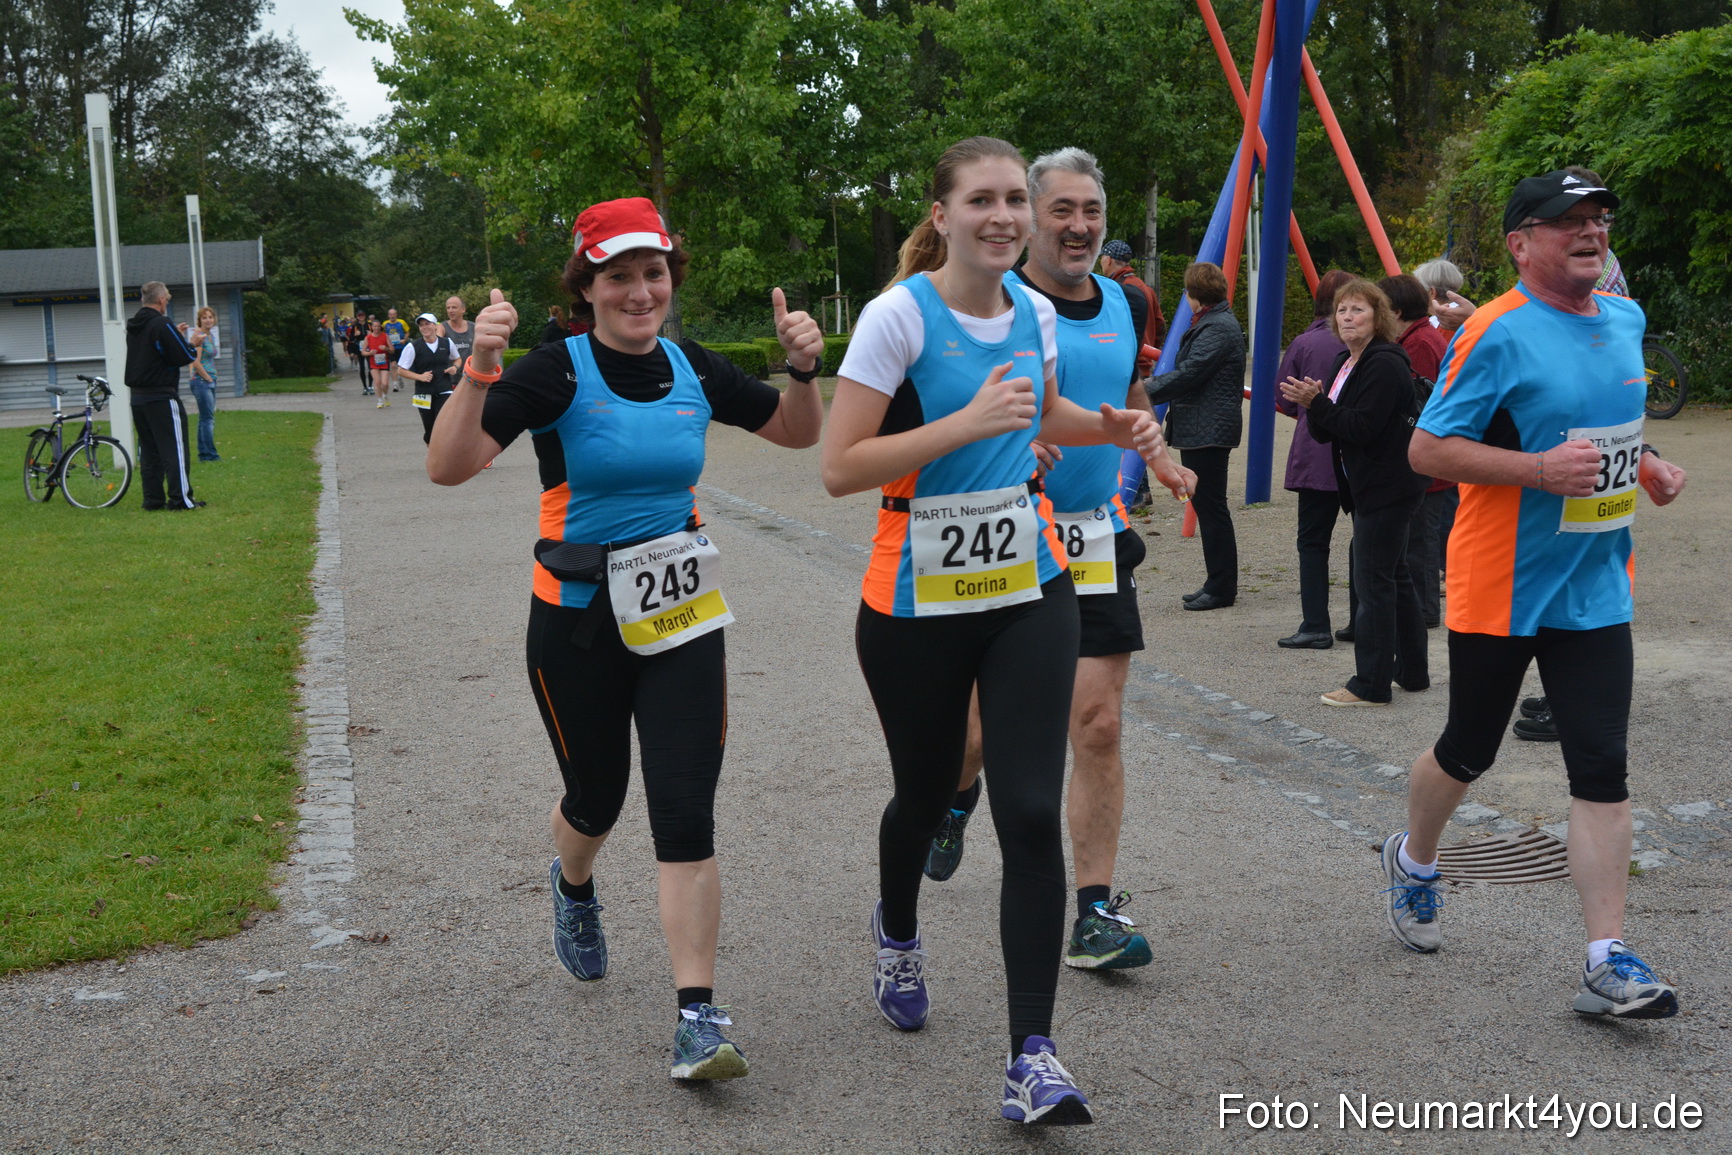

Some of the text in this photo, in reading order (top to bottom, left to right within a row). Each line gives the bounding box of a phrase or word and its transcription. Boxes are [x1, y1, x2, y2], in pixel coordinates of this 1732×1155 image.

[1594, 445, 1639, 493] 325
[913, 500, 1013, 521] PARTL Neumarkt
[1597, 498, 1633, 518] Günter
[610, 542, 696, 574] PARTL Neumarkt
[941, 517, 1017, 568] 242
[635, 556, 700, 613] 243
[955, 577, 1007, 596] Corina
[652, 606, 698, 636] Margit
